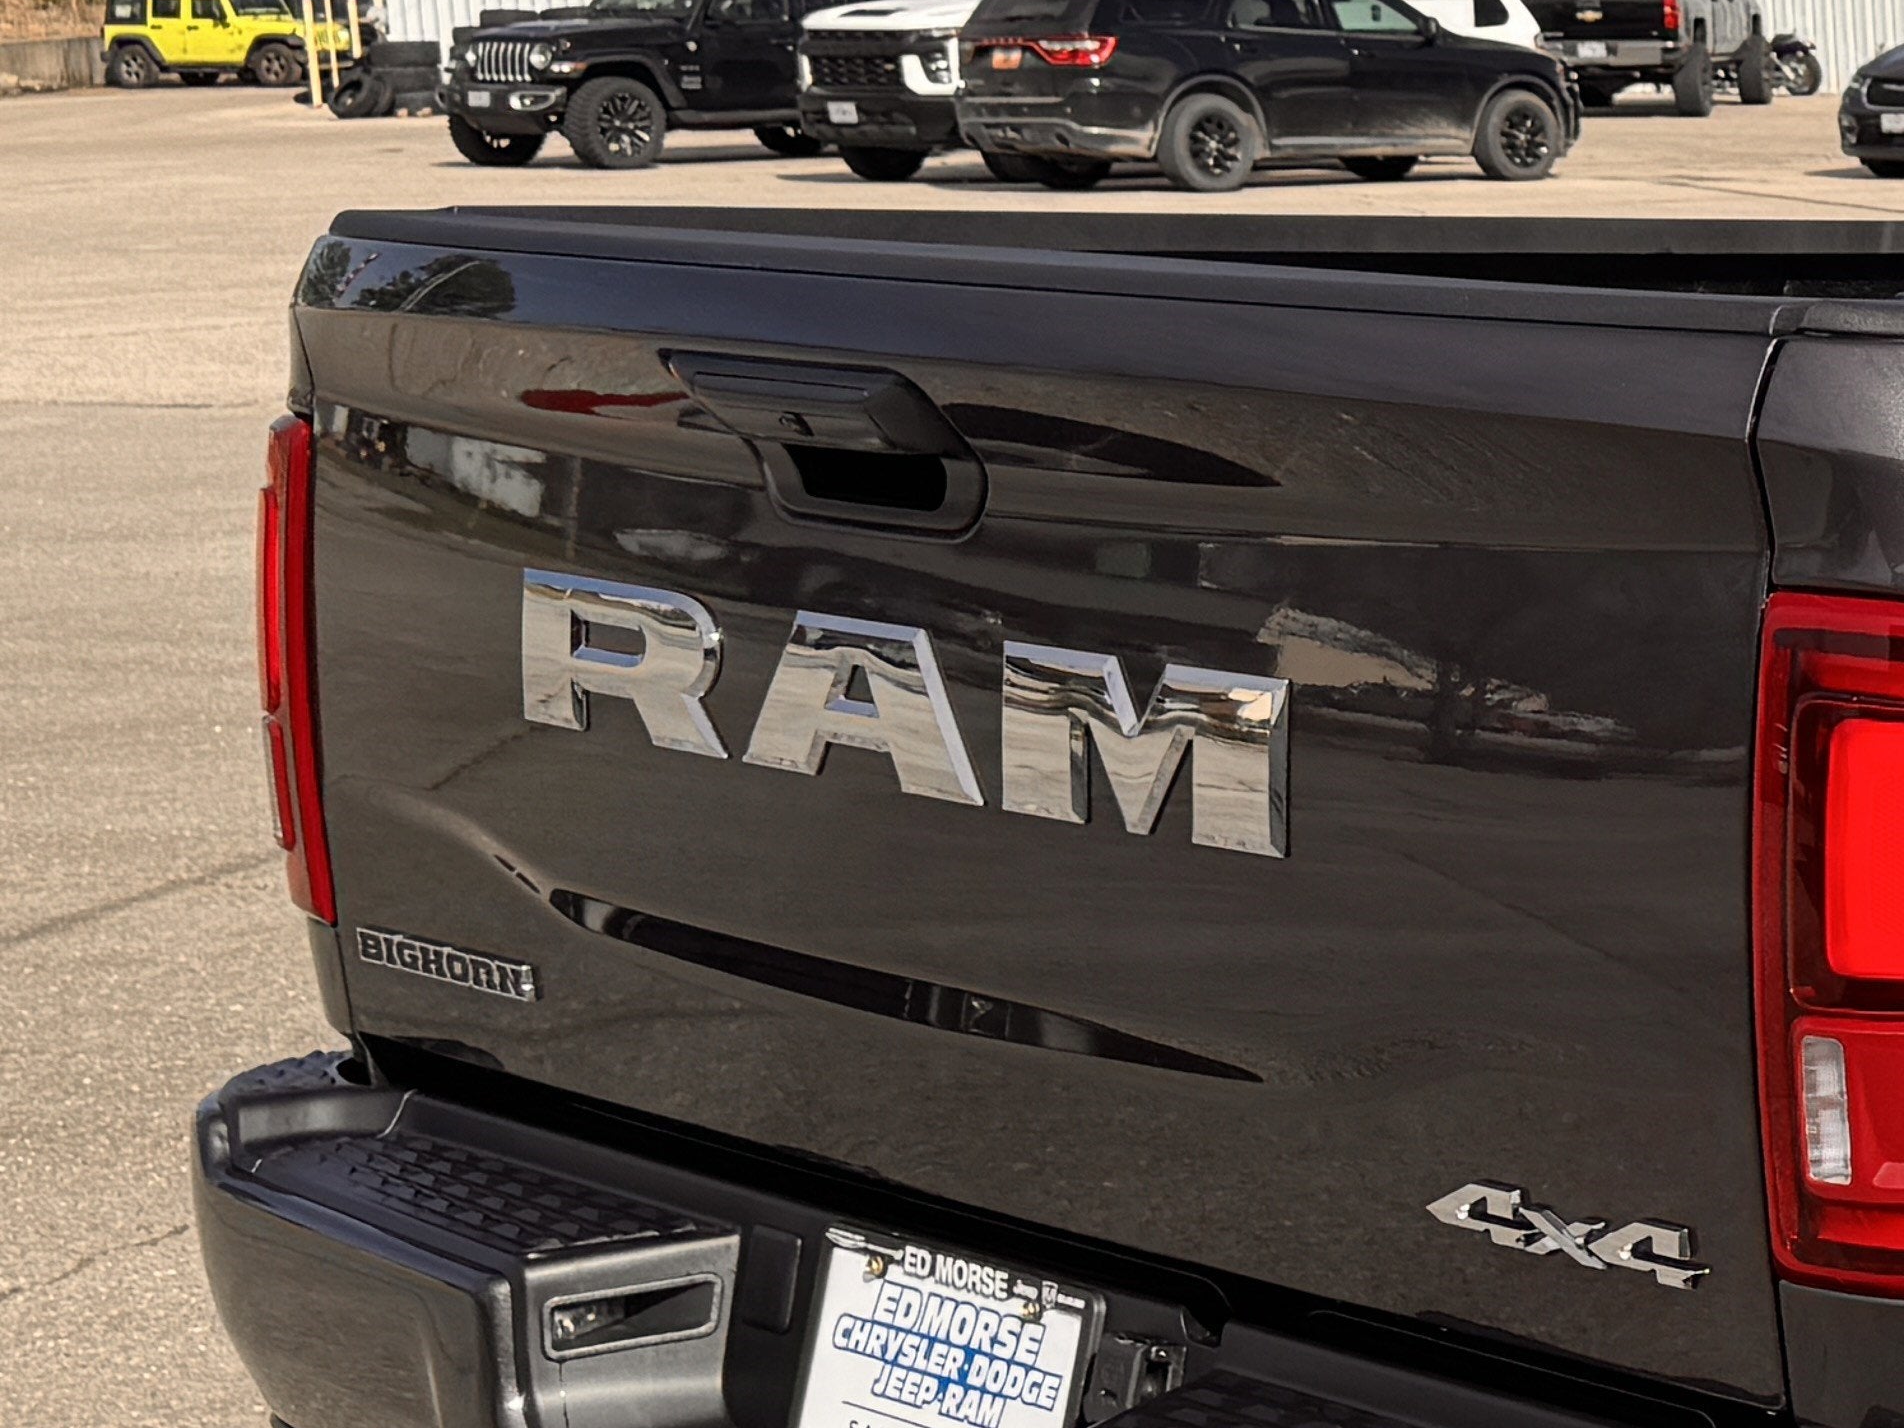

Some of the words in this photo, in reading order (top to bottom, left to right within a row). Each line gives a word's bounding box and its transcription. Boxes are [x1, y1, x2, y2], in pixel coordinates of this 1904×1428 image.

[523, 567, 1292, 858] RAM
[356, 927, 538, 1003] BIGHORN
[903, 1245, 933, 1278] ED
[934, 1254, 1010, 1300] MORSE
[872, 1279, 924, 1331] ED
[914, 1291, 1046, 1368] MORSE
